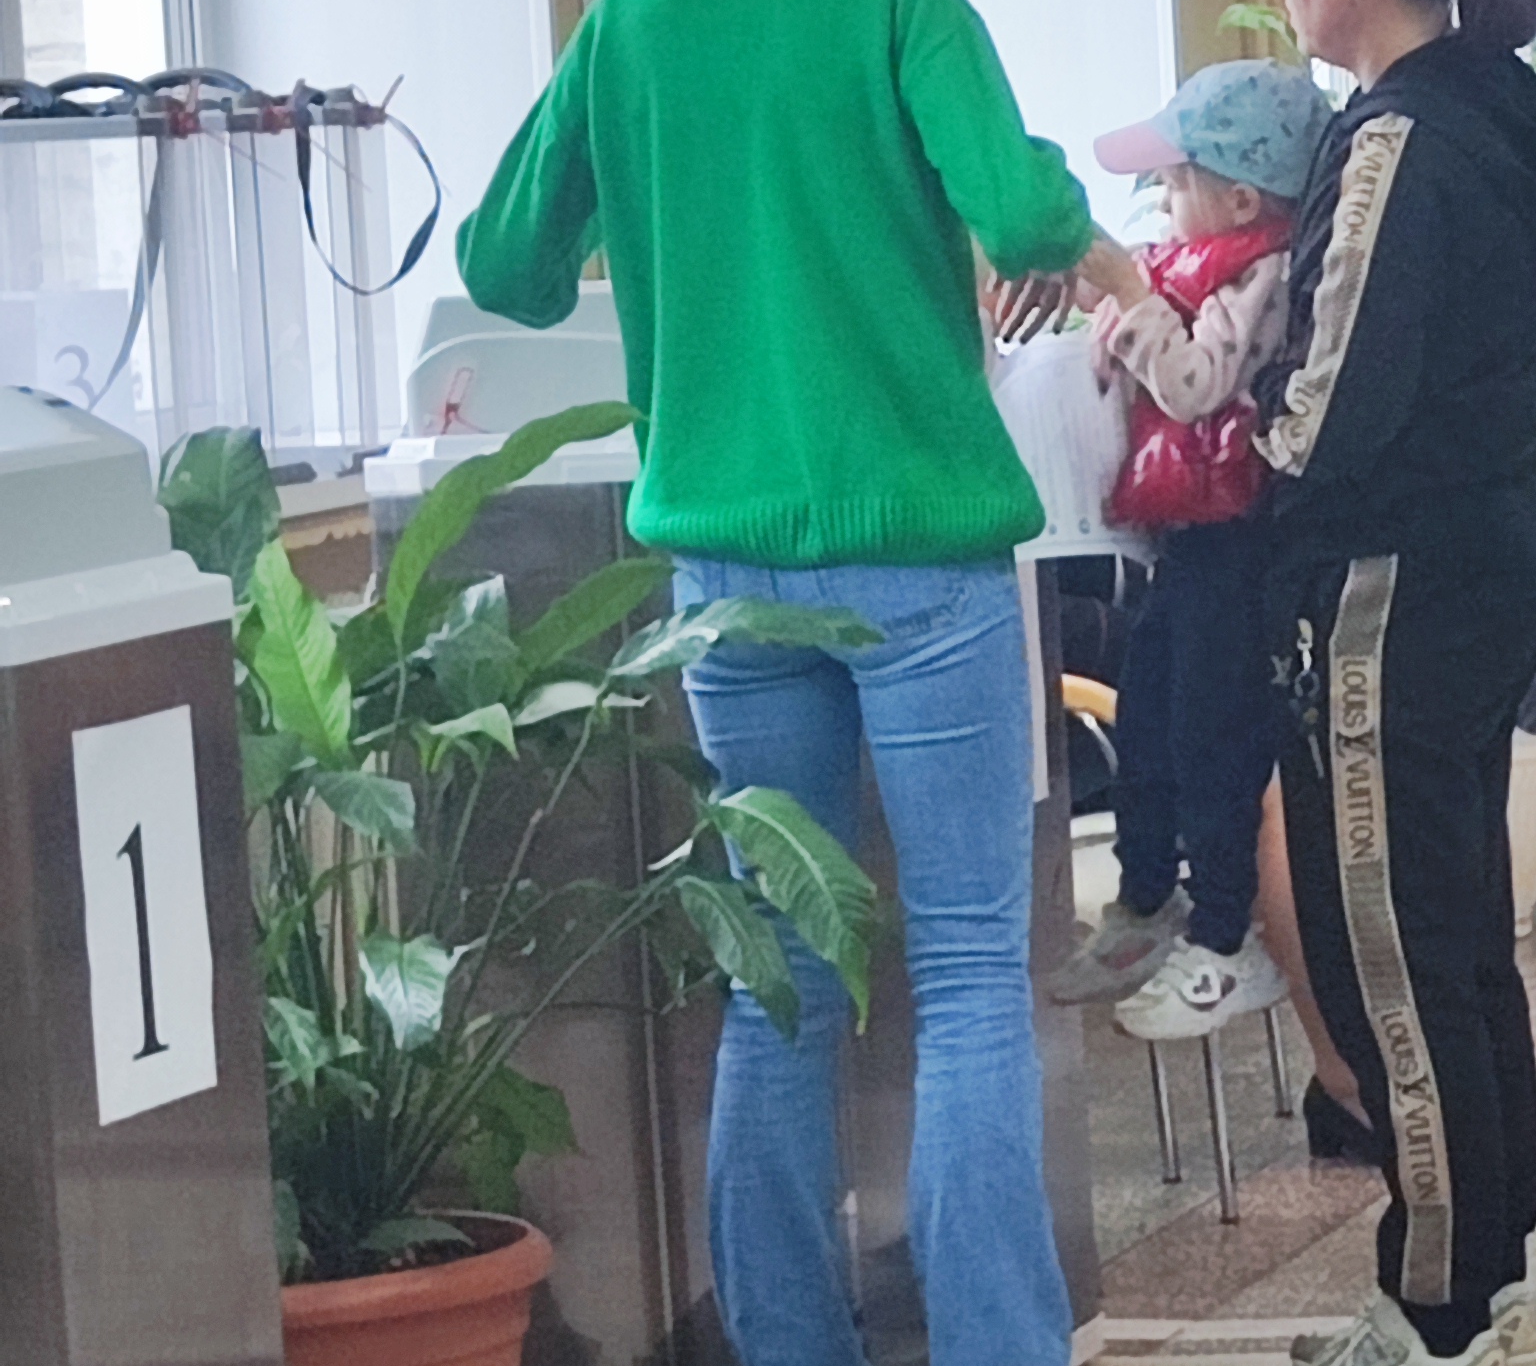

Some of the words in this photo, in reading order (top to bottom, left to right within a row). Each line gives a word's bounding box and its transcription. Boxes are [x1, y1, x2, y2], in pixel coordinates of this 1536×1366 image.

[1343, 151, 1385, 244] VUITTON
[1341, 658, 1369, 729] LOUIS
[1345, 756, 1377, 861] VUITTON
[116, 822, 170, 1060] 1
[1380, 1010, 1419, 1078] LOUIS
[1404, 1104, 1440, 1202] VUITTON
